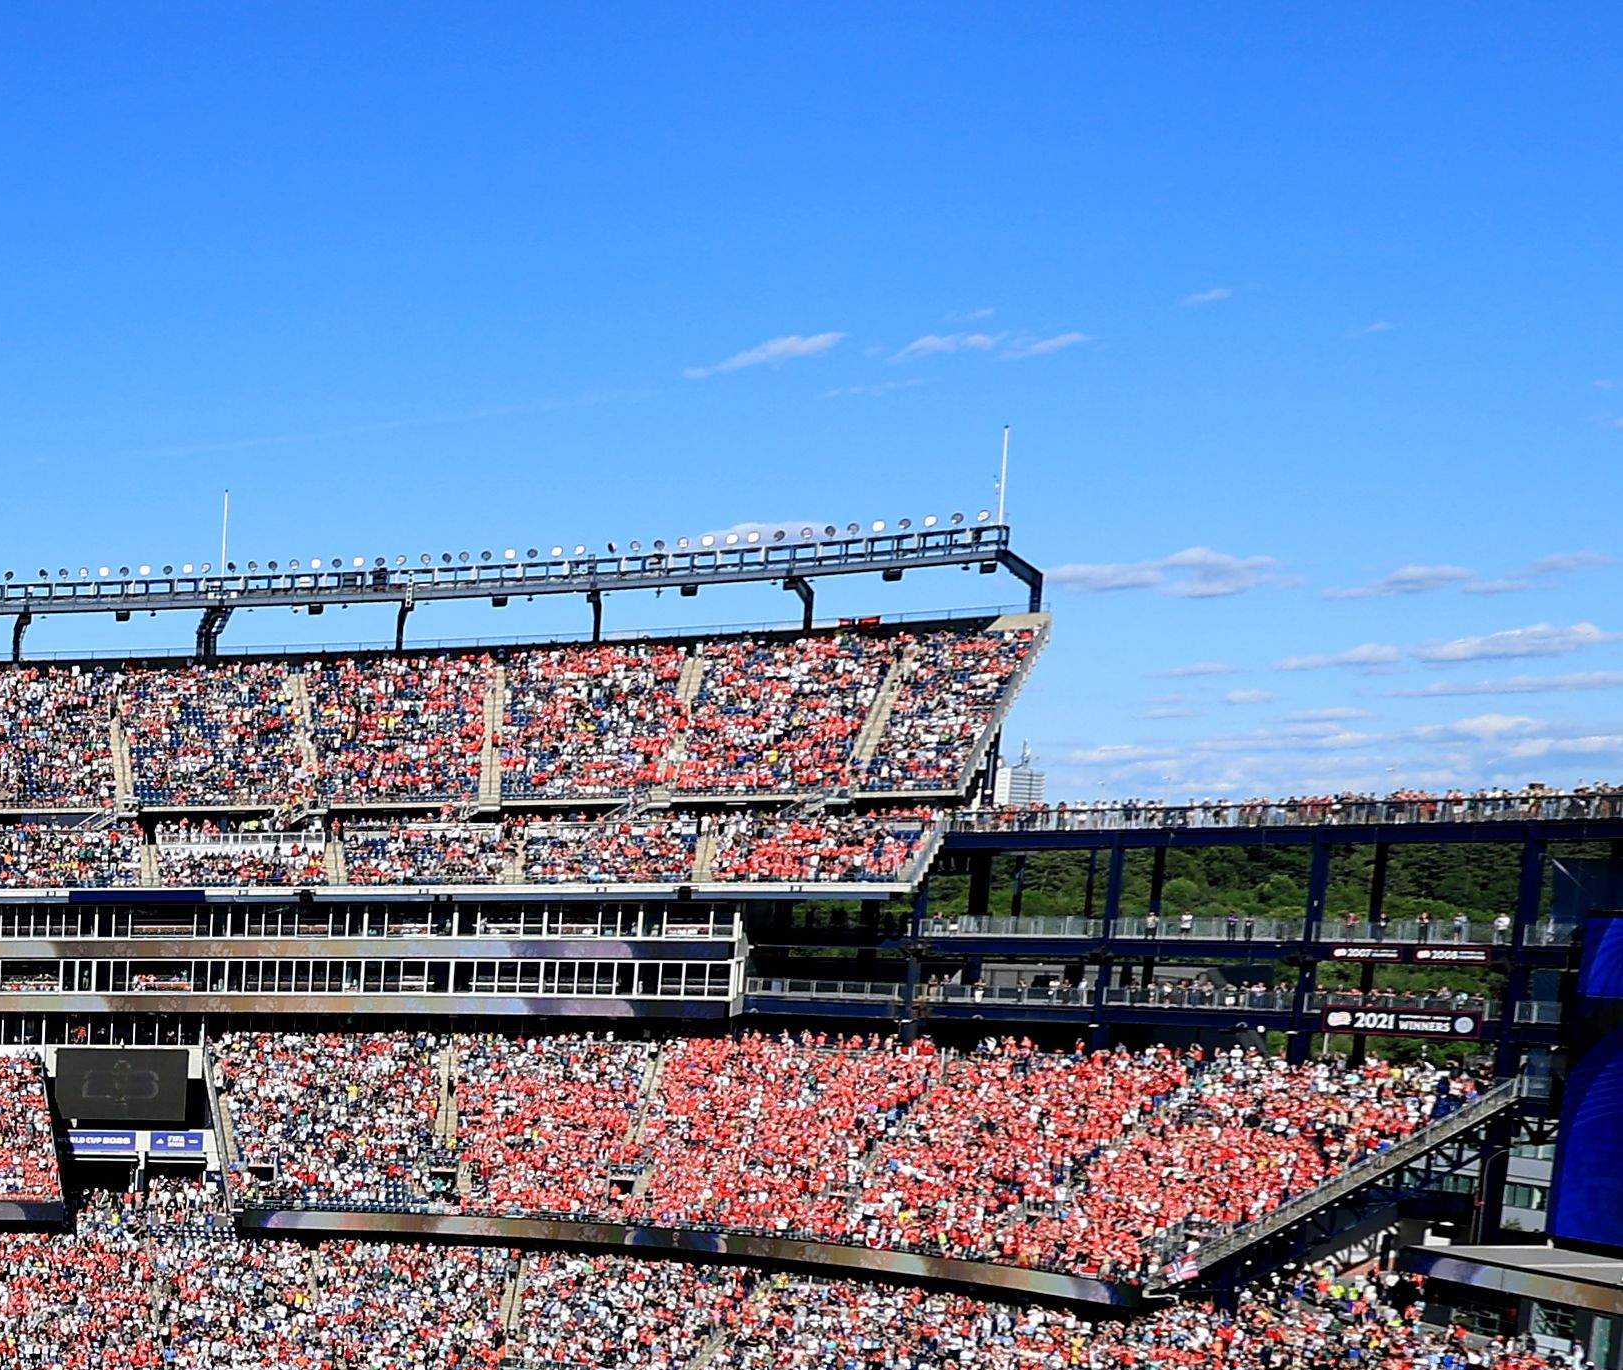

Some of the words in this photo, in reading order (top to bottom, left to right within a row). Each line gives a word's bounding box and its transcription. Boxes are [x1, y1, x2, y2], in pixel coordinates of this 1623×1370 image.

[1353, 1012, 1395, 1030] 2021
[1398, 1020, 1451, 1032] WINNERS
[102, 1137, 131, 1145] 2026
